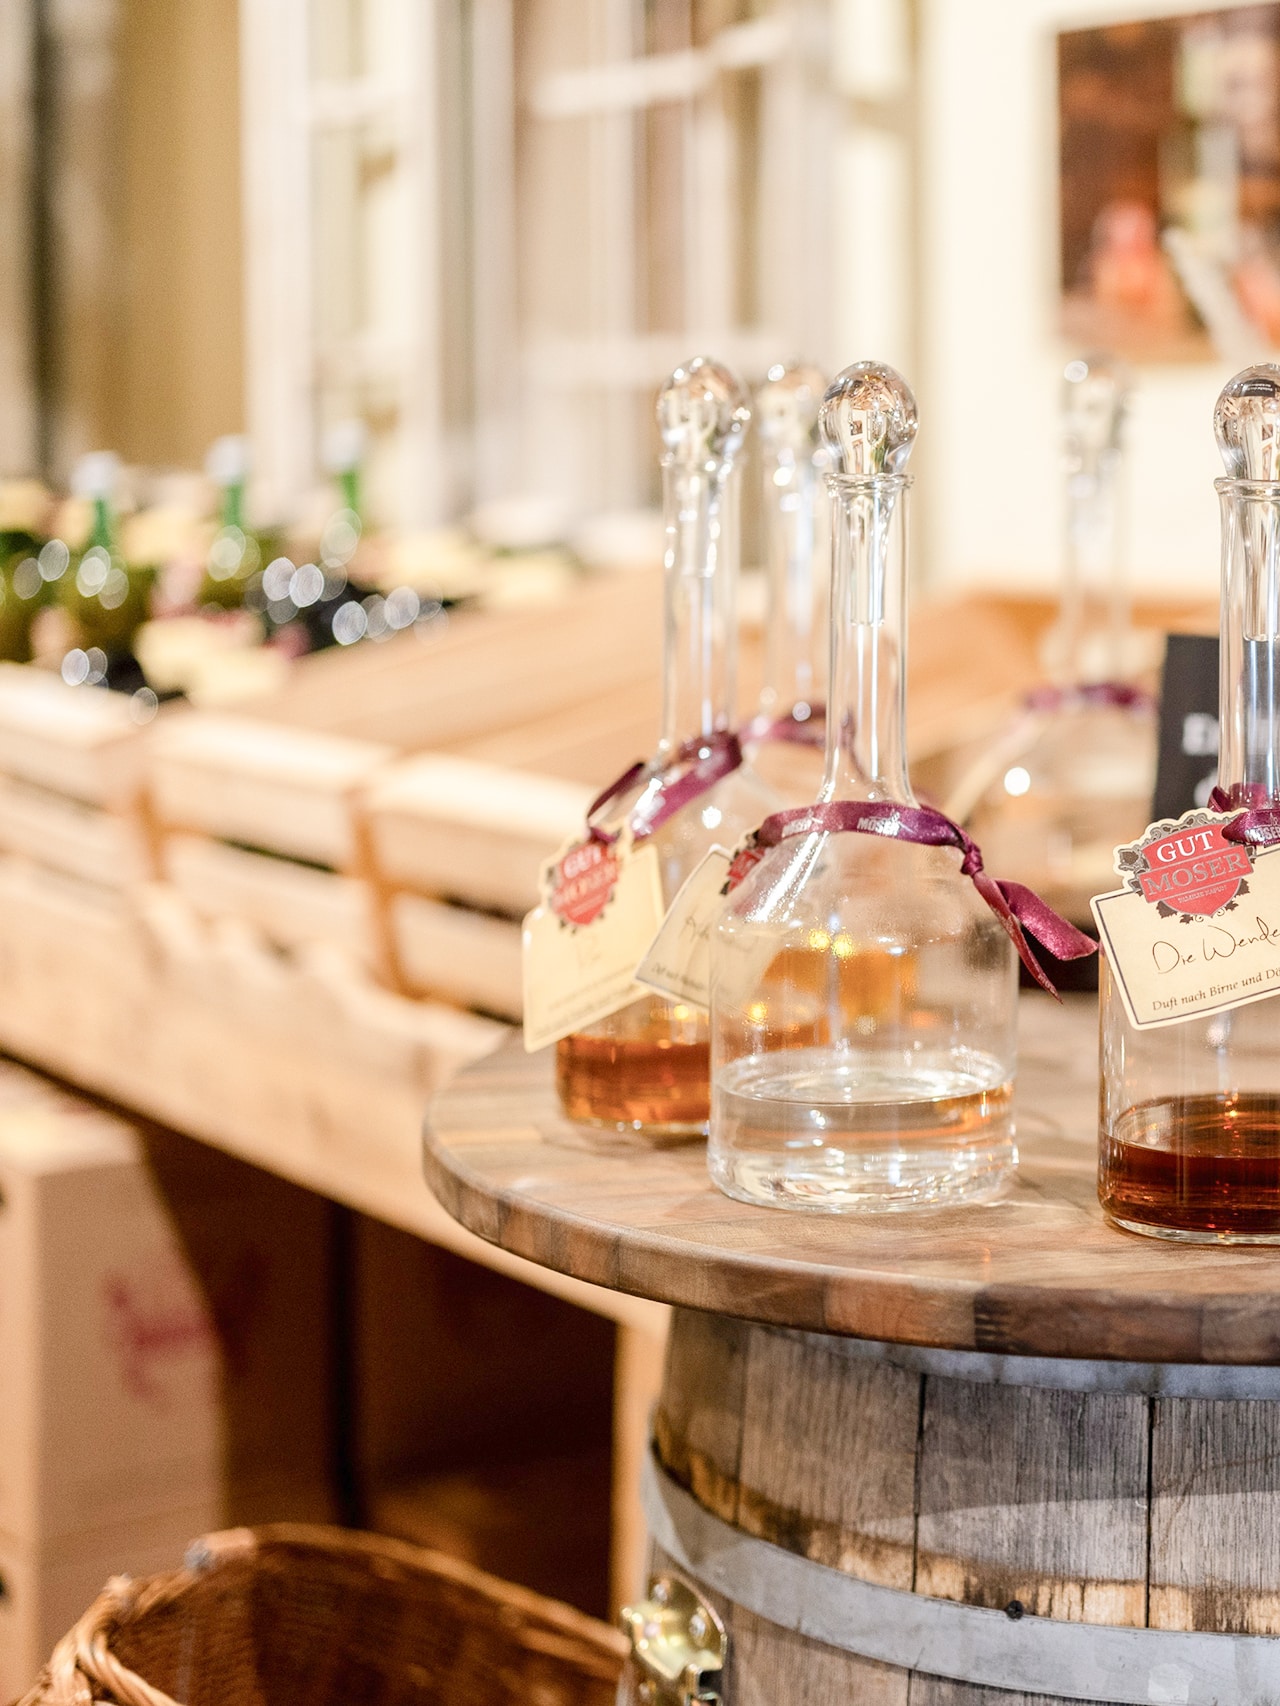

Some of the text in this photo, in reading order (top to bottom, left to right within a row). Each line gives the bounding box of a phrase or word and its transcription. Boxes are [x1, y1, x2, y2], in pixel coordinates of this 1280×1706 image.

[857, 816, 900, 837] MOSER
[1157, 830, 1214, 862] GUT
[1144, 852, 1247, 896] MOSER
[1152, 940, 1197, 974] Die
[1152, 996, 1178, 1011] Duft
[1181, 990, 1207, 1005] nach
[1209, 982, 1239, 997] Birne
[1242, 972, 1263, 988] und
